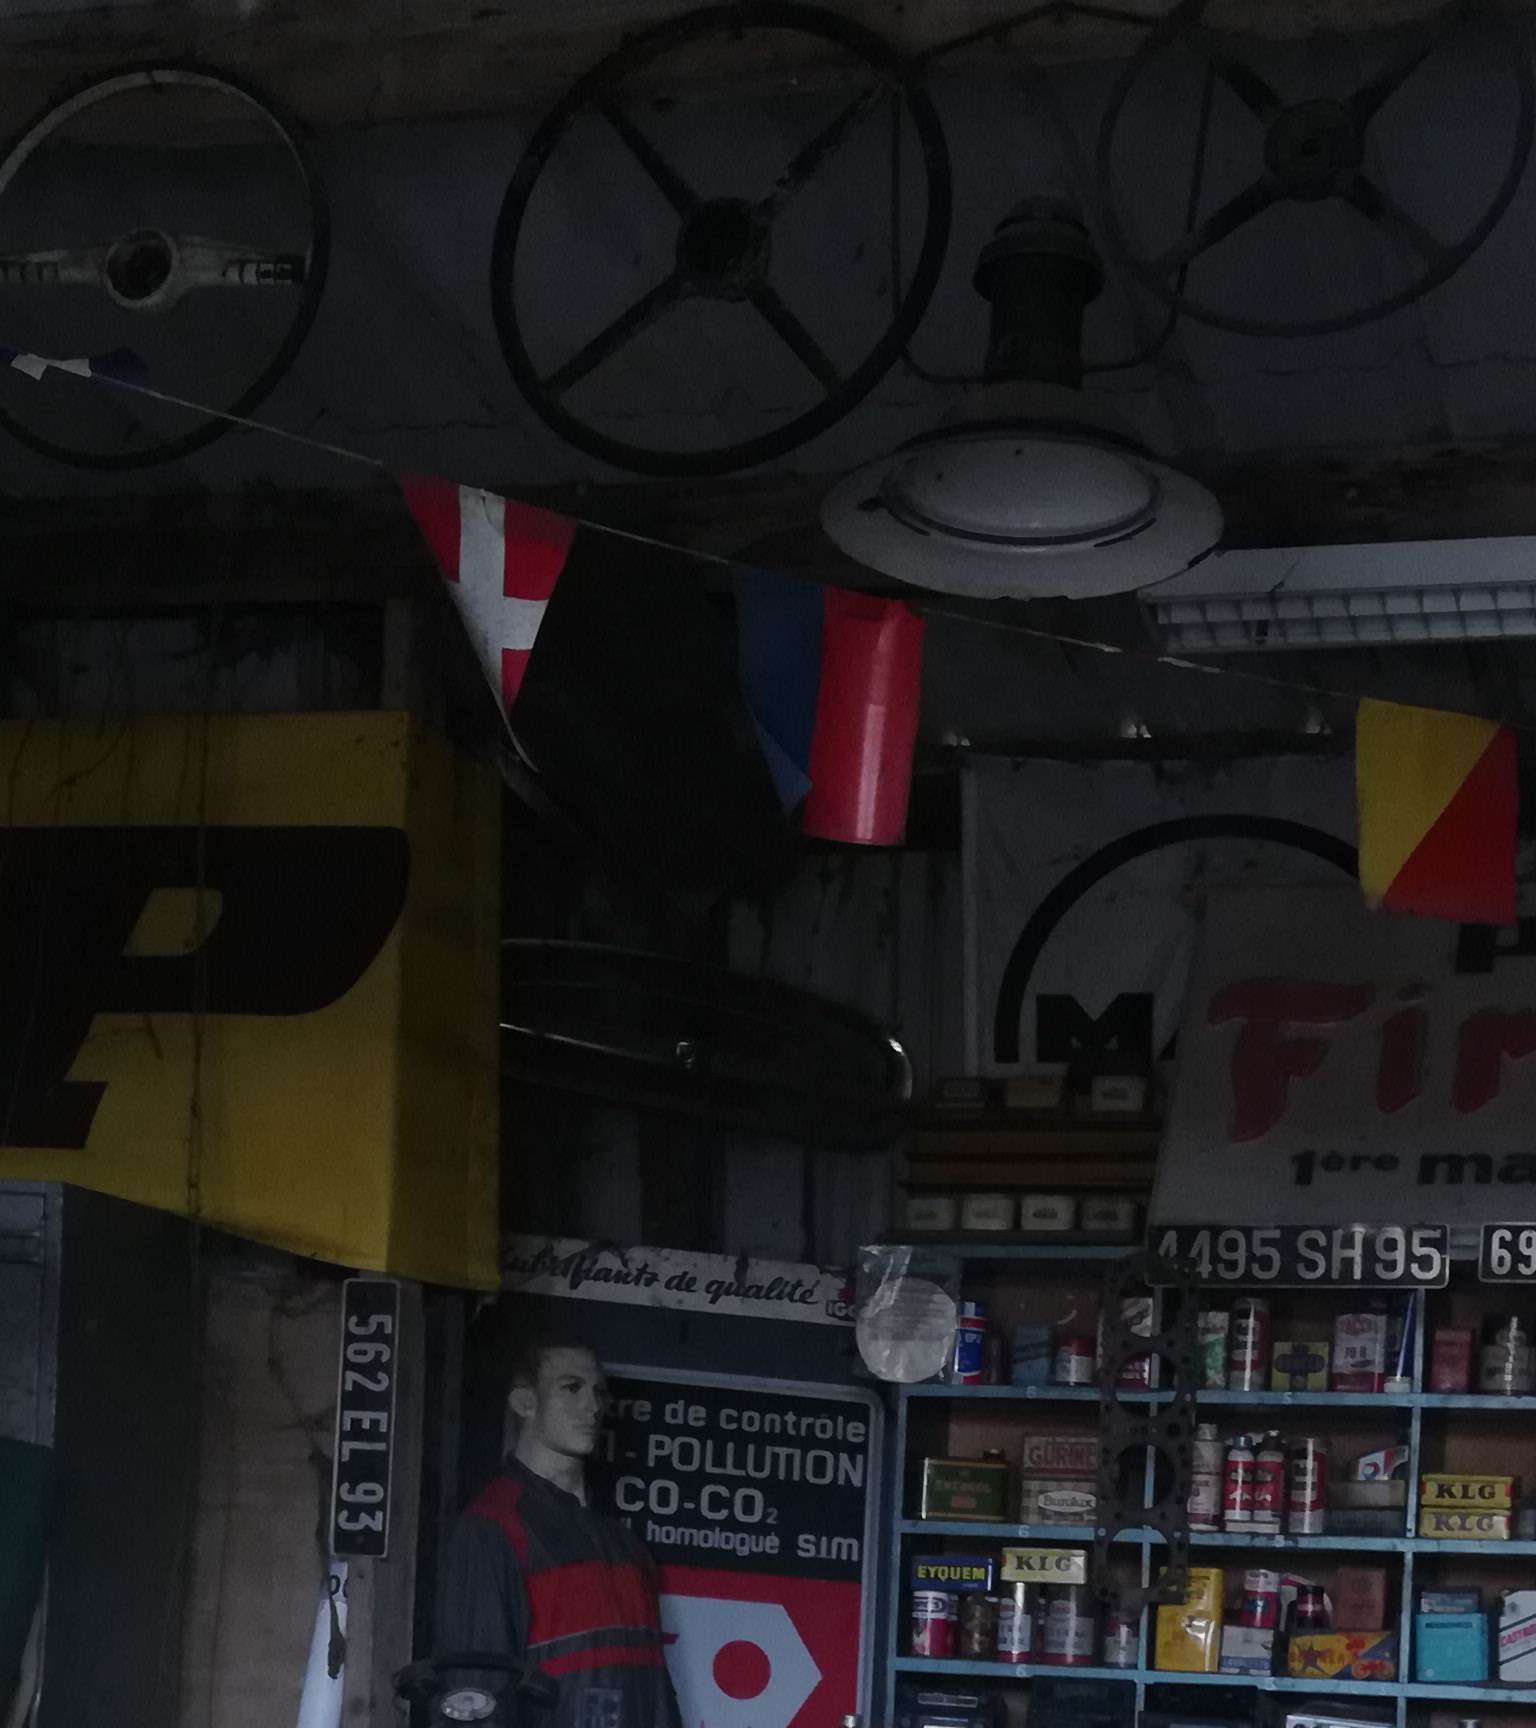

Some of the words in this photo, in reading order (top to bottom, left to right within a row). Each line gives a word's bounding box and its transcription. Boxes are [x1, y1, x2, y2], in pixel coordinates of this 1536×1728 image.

[664, 1271, 697, 1293] de
[704, 1276, 820, 1307] qualité
[826, 1300, 858, 1319] IGO
[344, 1312, 394, 1393] 562
[663, 1400, 707, 1426] de
[340, 1408, 389, 1462] EL
[647, 1434, 865, 1488] POLLUTION
[337, 1481, 385, 1533] 93
[1435, 1482, 1497, 1502] KLG
[1432, 1513, 1496, 1533] KLG
[916, 1565, 987, 1582] EYQUEM
